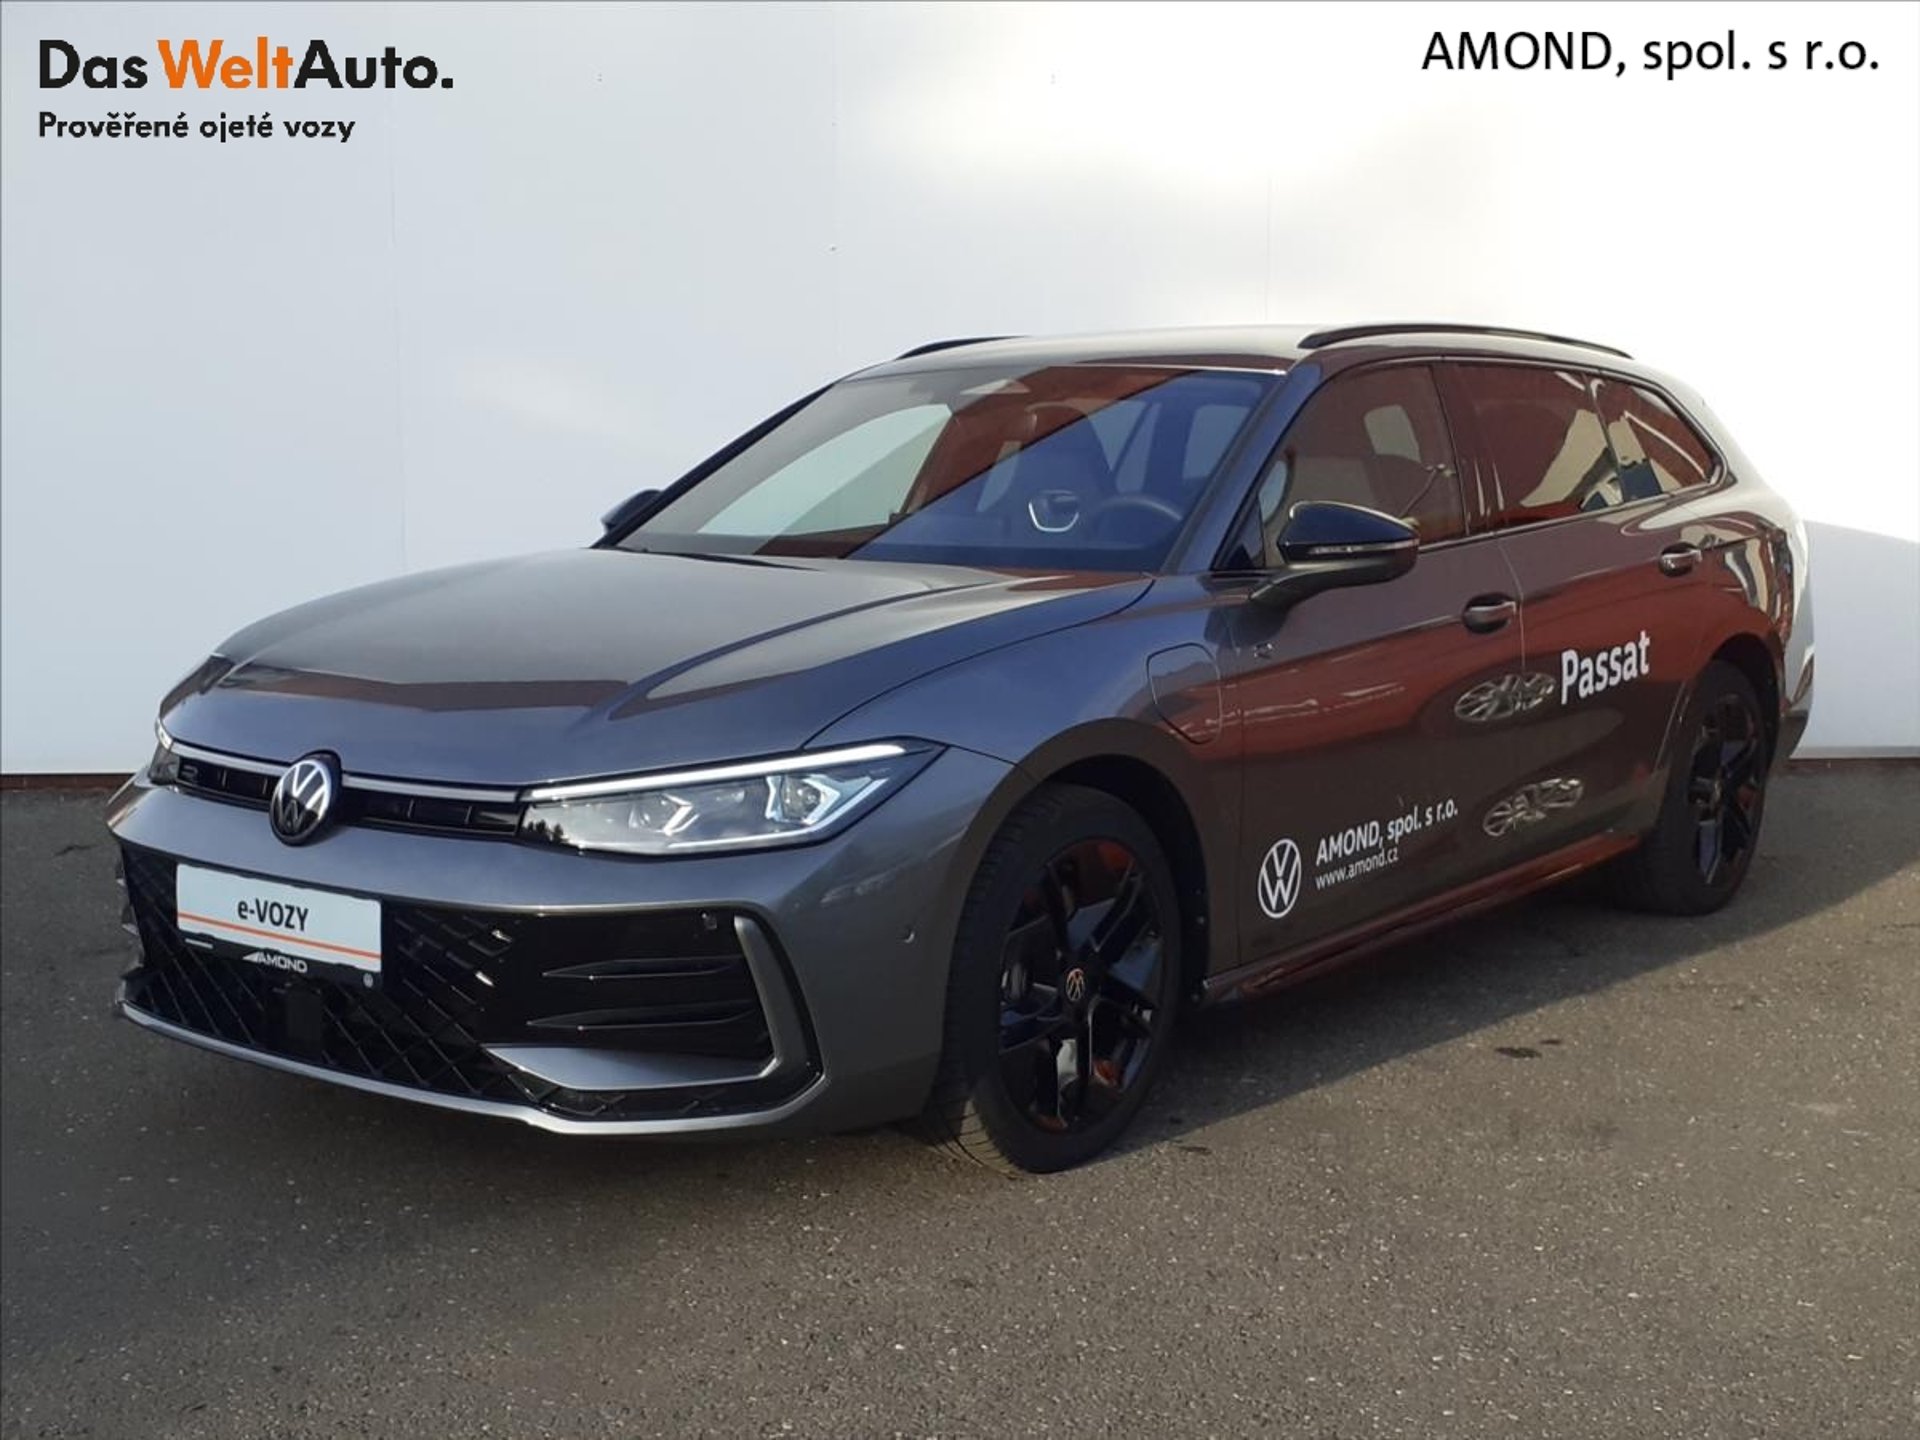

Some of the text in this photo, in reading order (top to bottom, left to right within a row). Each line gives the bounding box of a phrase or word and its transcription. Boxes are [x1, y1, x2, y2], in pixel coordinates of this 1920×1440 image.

[1561, 630, 1650, 705] Passat
[1316, 799, 1458, 866] AMOND, spol. s r.o.
[1315, 847, 1399, 890] www.amond.cz
[237, 898, 309, 932] e-VOZY
